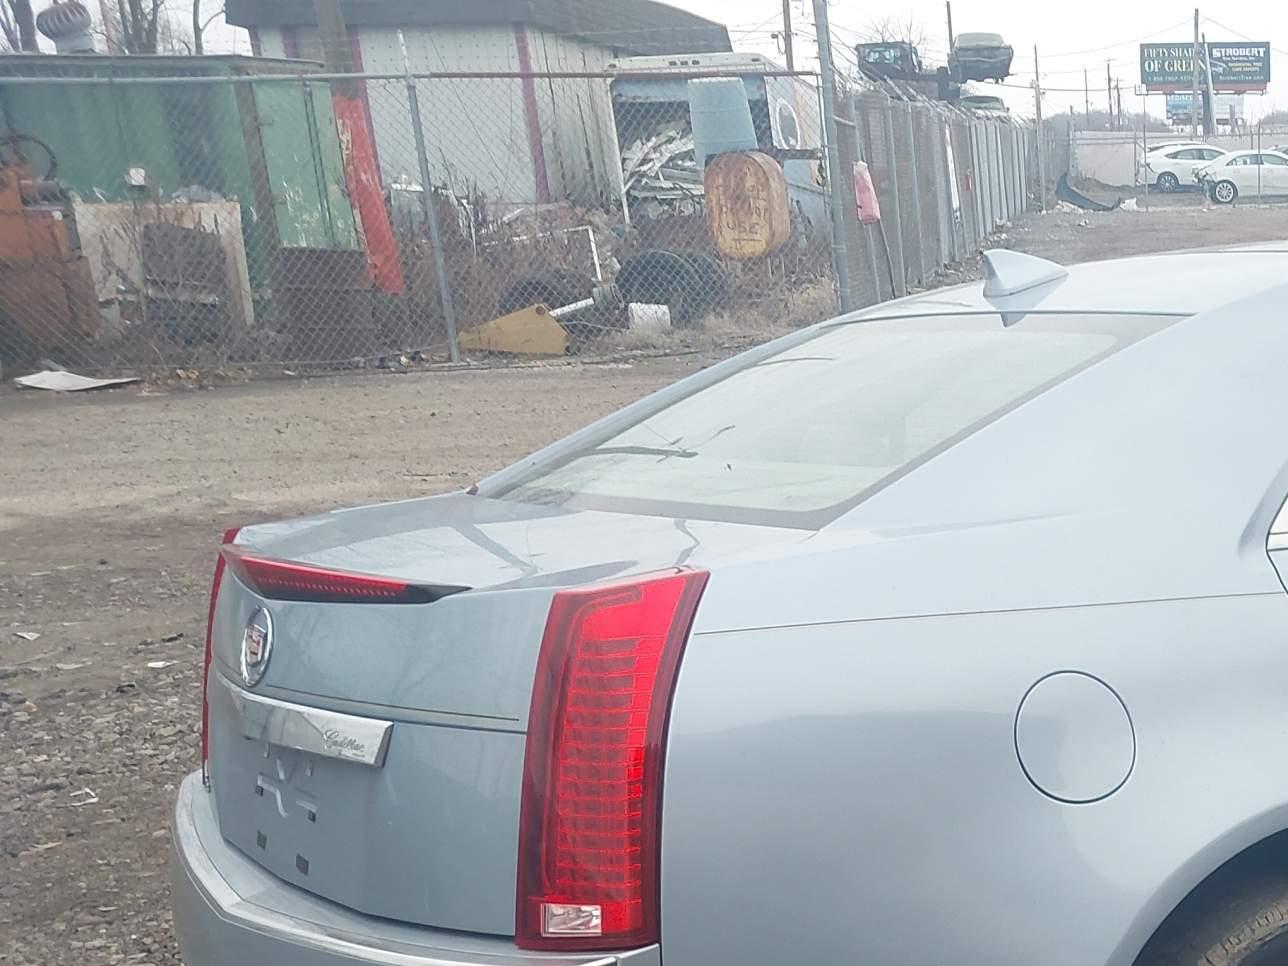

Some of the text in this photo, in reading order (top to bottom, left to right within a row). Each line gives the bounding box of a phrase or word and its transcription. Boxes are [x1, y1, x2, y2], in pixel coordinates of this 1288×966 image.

[1144, 47, 1169, 58] FIFTY
[1212, 47, 1266, 57] STROBERT
[1145, 60, 1162, 73] OF
[325, 729, 365, 752] Cadillac
